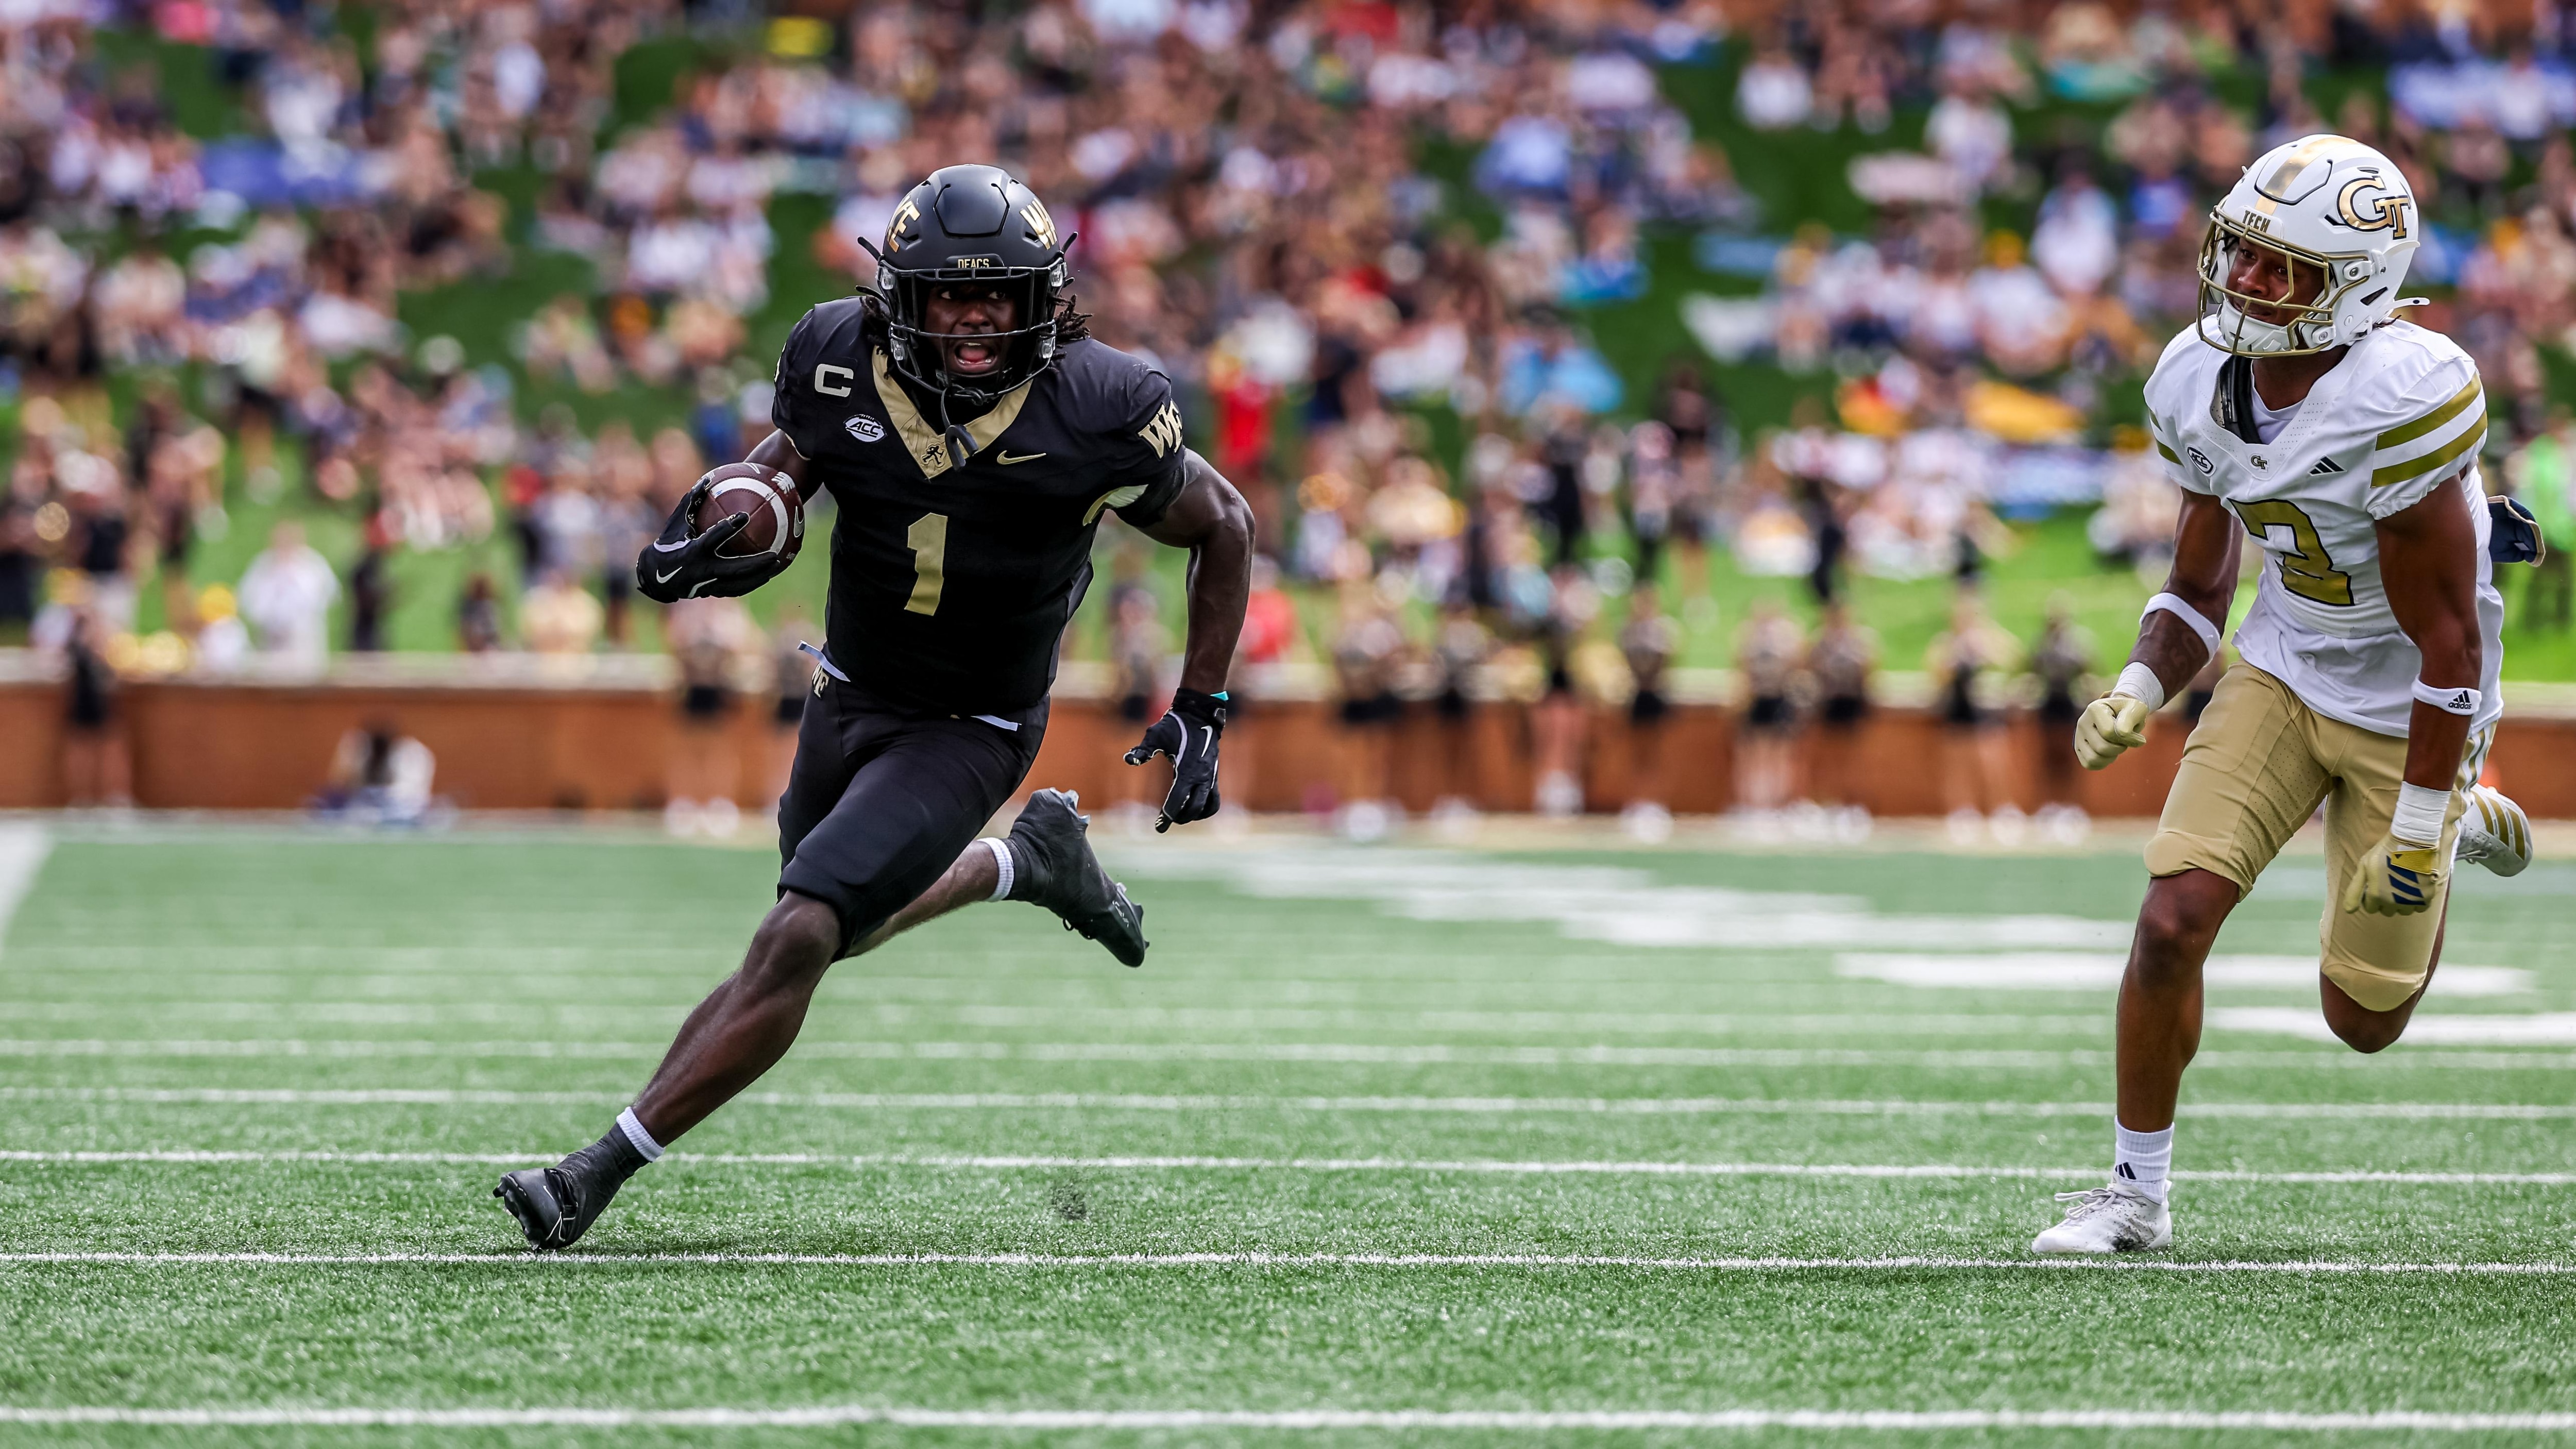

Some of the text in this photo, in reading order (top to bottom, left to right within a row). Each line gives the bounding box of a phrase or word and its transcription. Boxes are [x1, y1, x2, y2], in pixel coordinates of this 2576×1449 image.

[2337, 175, 2411, 240] GT
[2242, 210, 2271, 233] TECH
[958, 258, 990, 268] DEACS
[815, 363, 854, 397] C
[849, 421, 882, 436] ACC
[2250, 455, 2268, 470] GT
[904, 512, 948, 616] 1
